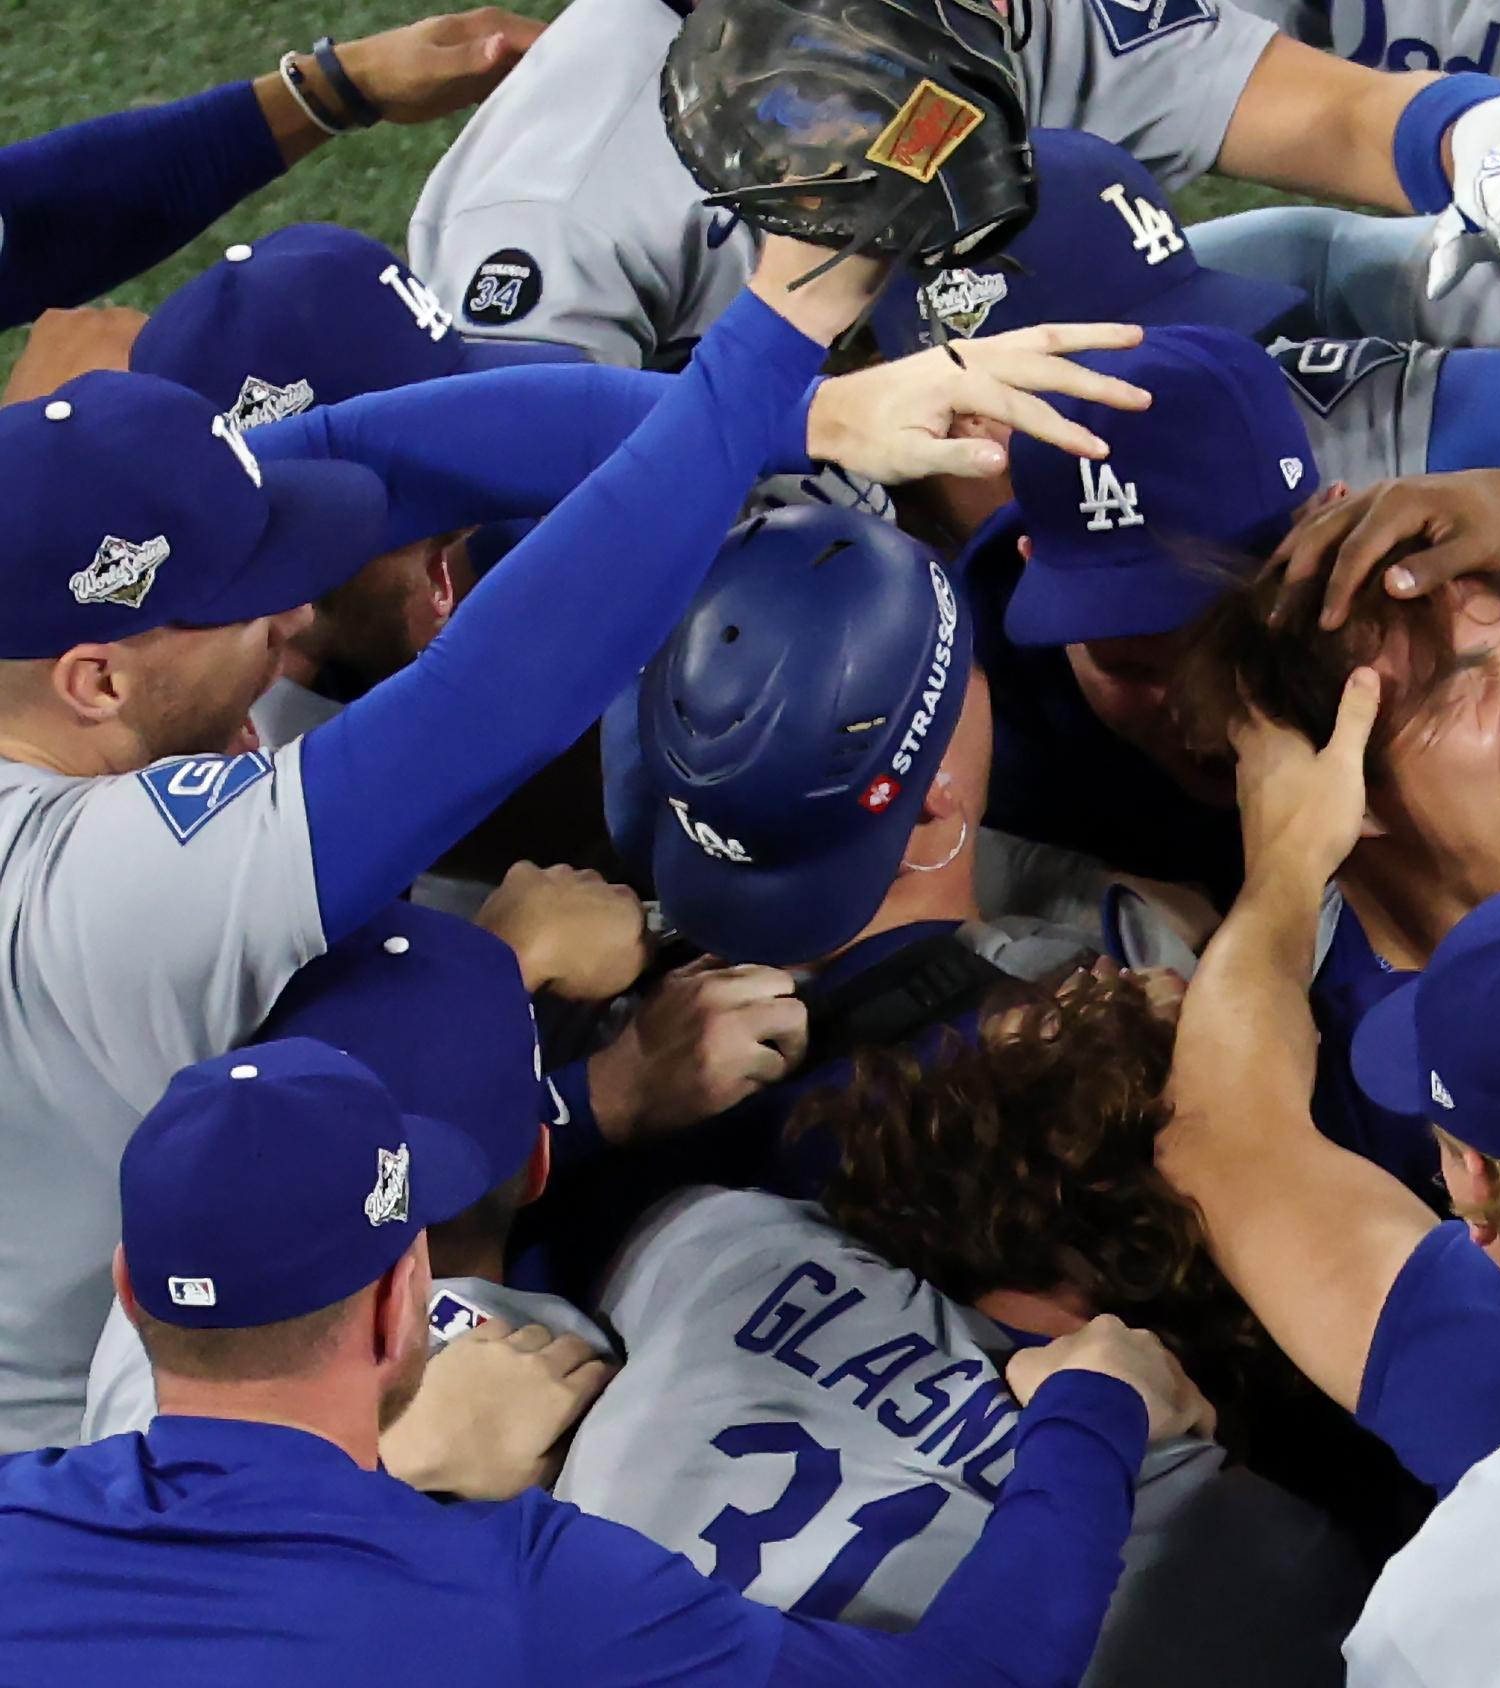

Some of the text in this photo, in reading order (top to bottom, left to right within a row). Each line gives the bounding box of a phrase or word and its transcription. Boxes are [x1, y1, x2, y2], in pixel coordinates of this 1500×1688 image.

[1099, 183, 1185, 266] LA
[379, 264, 453, 341] LA
[470, 276, 522, 316] 34
[1079, 456, 1145, 531] LA
[891, 622, 955, 776] STRAUSS
[668, 797, 752, 862] LA
[733, 1260, 1022, 1506] GLASNO
[698, 1421, 951, 1622] 31
